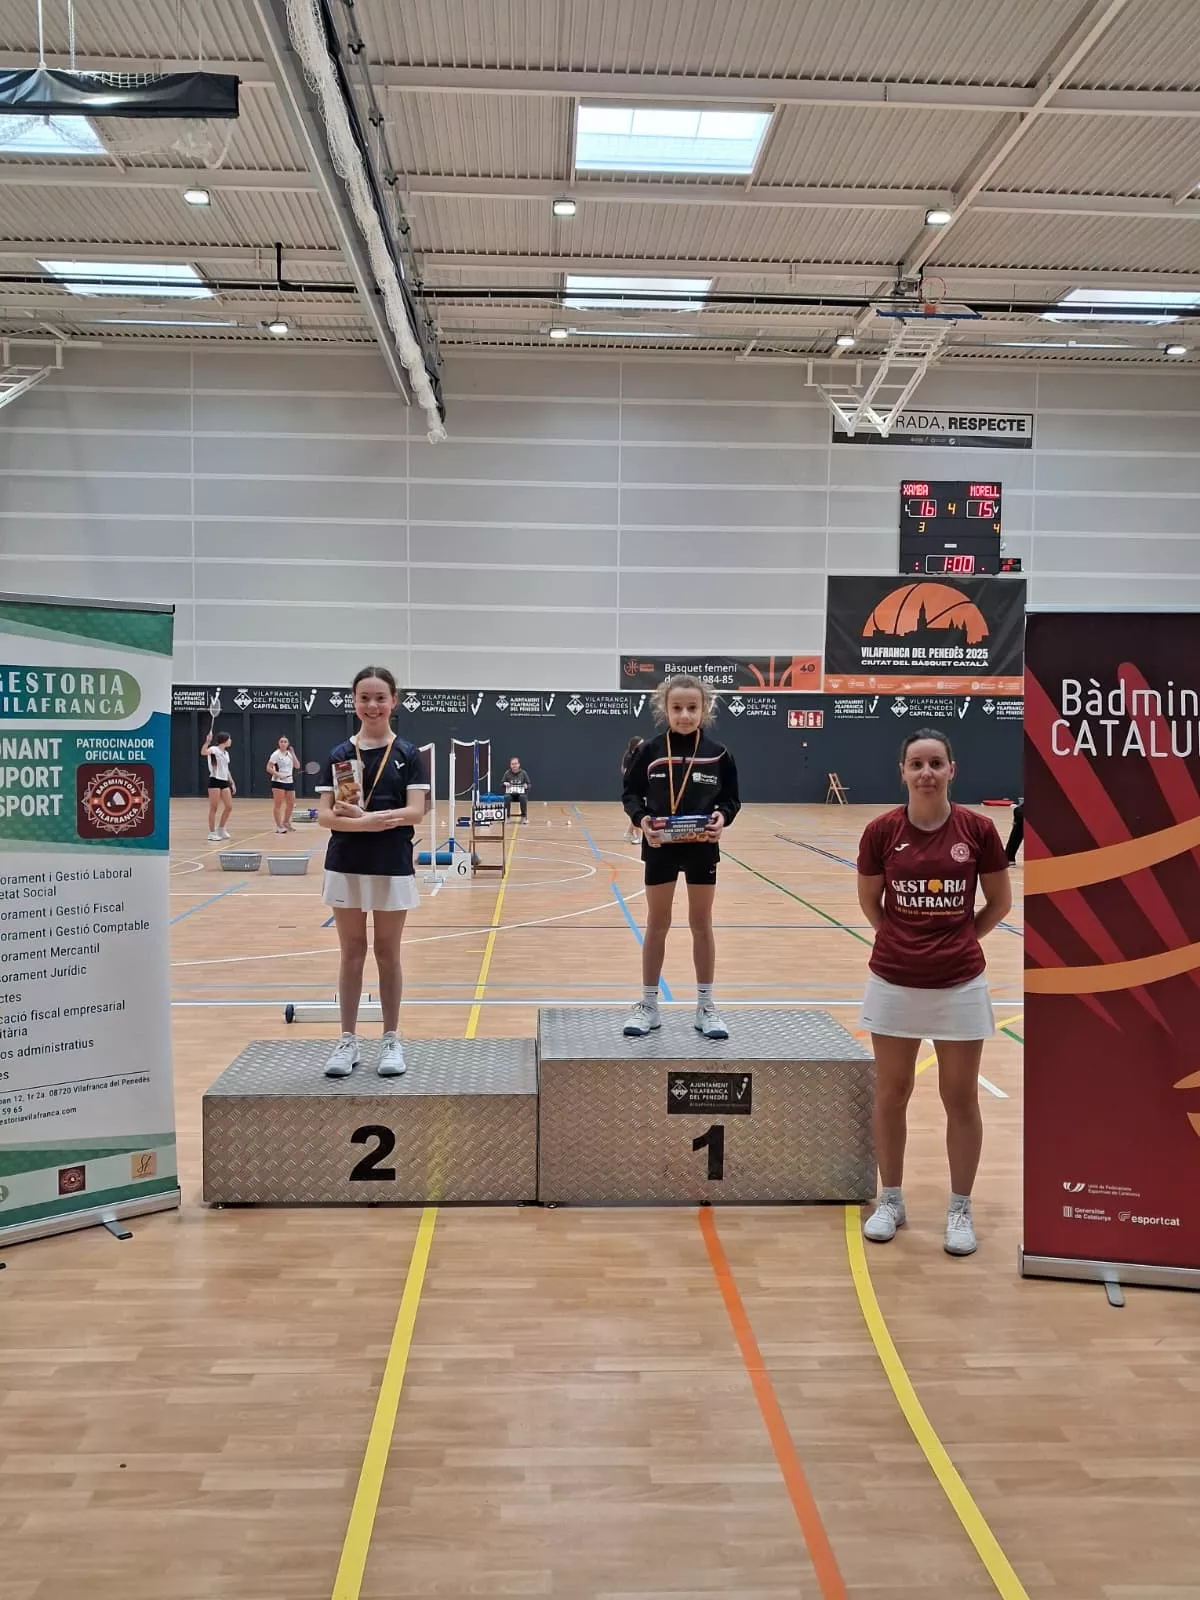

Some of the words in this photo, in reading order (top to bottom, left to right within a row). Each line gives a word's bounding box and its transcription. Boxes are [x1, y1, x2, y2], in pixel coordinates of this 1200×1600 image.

[948, 416, 1026, 432] RESPECTE
[903, 484, 929, 496] XAMBA
[920, 501, 935, 516] 16
[948, 503, 956, 514] 4
[978, 502, 992, 517] 15
[918, 521, 926, 533] 3
[993, 523, 1000, 533] 4
[943, 556, 973, 572] 1:00
[861, 646, 910, 658] VILAFRANCA
[912, 647, 927, 658] DEL
[929, 645, 964, 659] PENEDÈS
[966, 648, 989, 659] 2025
[665, 662, 703, 676] Bàsquet
[704, 663, 737, 673] femení
[698, 675, 734, 684] 1984-85
[3, 697, 125, 714] ILAFRANCA
[76, 738, 154, 749] PATROCINADOR
[1051, 719, 1200, 758] CATALU
[0, 738, 62, 760] NANT
[85, 750, 125, 761] OFICIAL
[128, 751, 146, 761] DEL
[95, 778, 137, 795] BADMINTON
[95, 808, 139, 824] VILAFRANCA
[476, 810, 484, 820] 0
[495, 810, 503, 819] 0
[49, 871, 53, 882] i
[55, 870, 90, 882] Gestió
[92, 867, 132, 880] Laboral
[457, 859, 467, 876] 6
[23, 886, 57, 898] Social
[49, 907, 53, 917] i
[55, 904, 90, 917] Gestió
[93, 901, 125, 914] Fiscal
[49, 927, 53, 937] i
[55, 924, 90, 937] Gestió
[93, 919, 150, 935] Comptable
[50, 943, 100, 958] Mercantil
[50, 965, 87, 978] Jurídic
[31, 1007, 60, 1021] fiscal
[63, 1000, 125, 1018] empresarial
[17, 1038, 94, 1057] administratius
[49, 1087, 72, 1097] 08720
[73, 1082, 108, 1093] Vilafranca
[110, 1080, 120, 1088] del
[348, 1124, 396, 1181] 2
[692, 1124, 725, 1181] 1
[1131, 1215, 1181, 1227] esportcat
